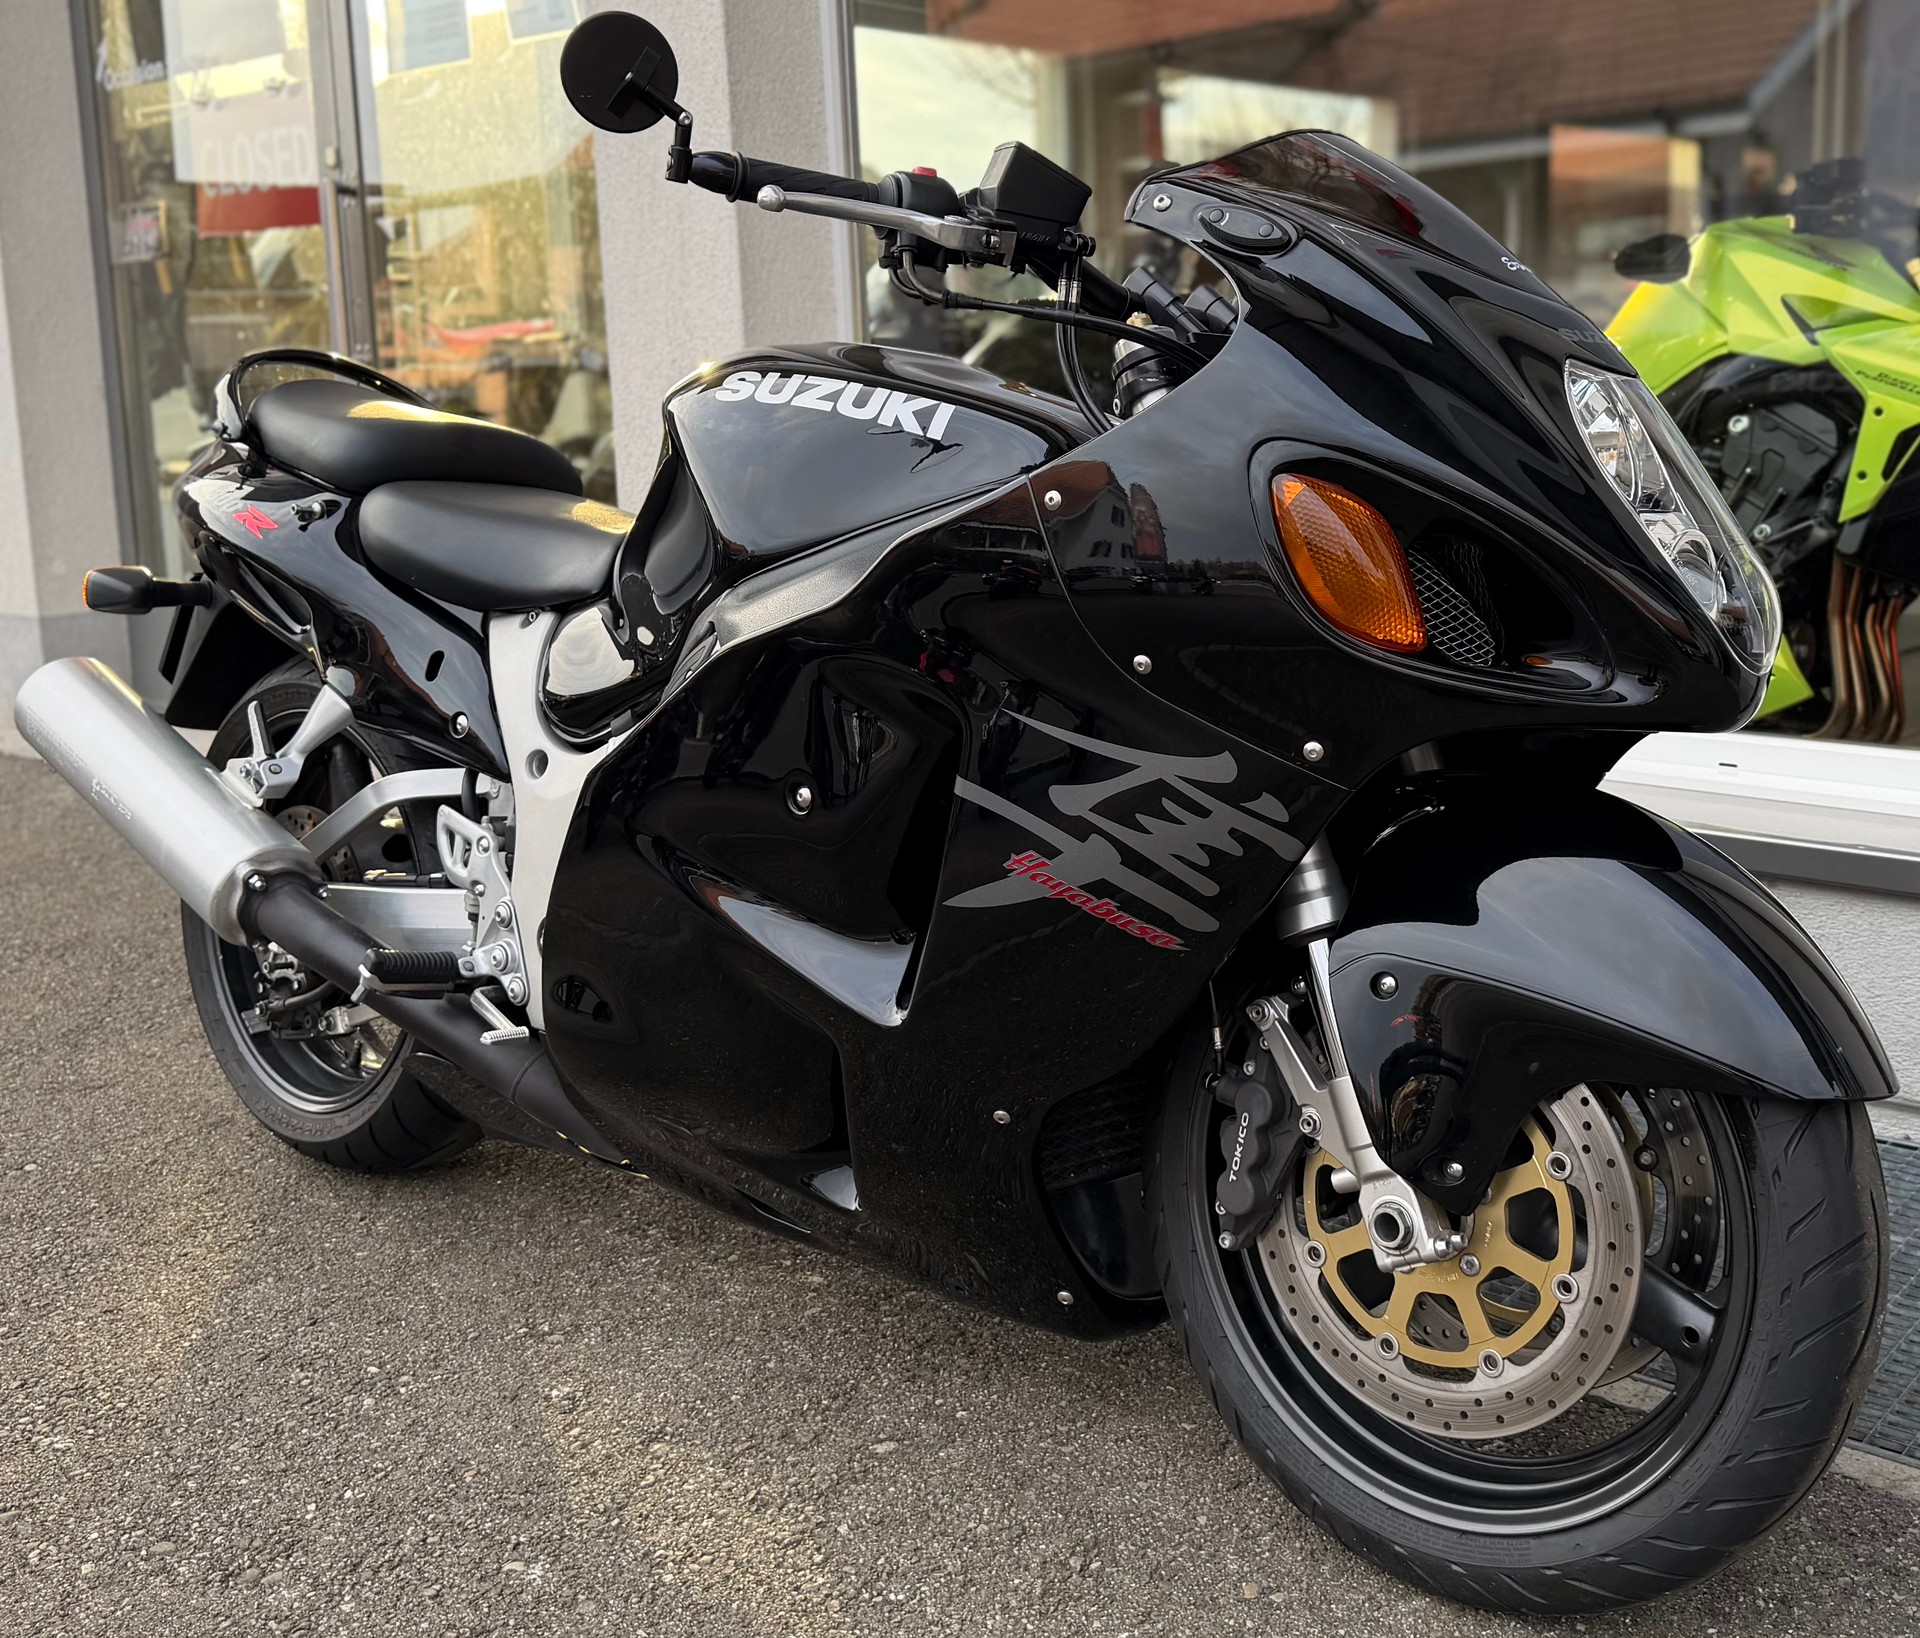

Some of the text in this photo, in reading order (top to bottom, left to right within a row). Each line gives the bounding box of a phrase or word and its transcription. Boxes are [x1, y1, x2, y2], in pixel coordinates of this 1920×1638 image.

[199, 124, 313, 198] CLOSED
[715, 370, 958, 441] SUZUKI
[1003, 848, 1192, 952] Hayabusa
[1228, 1111, 1250, 1183] TOKICO
